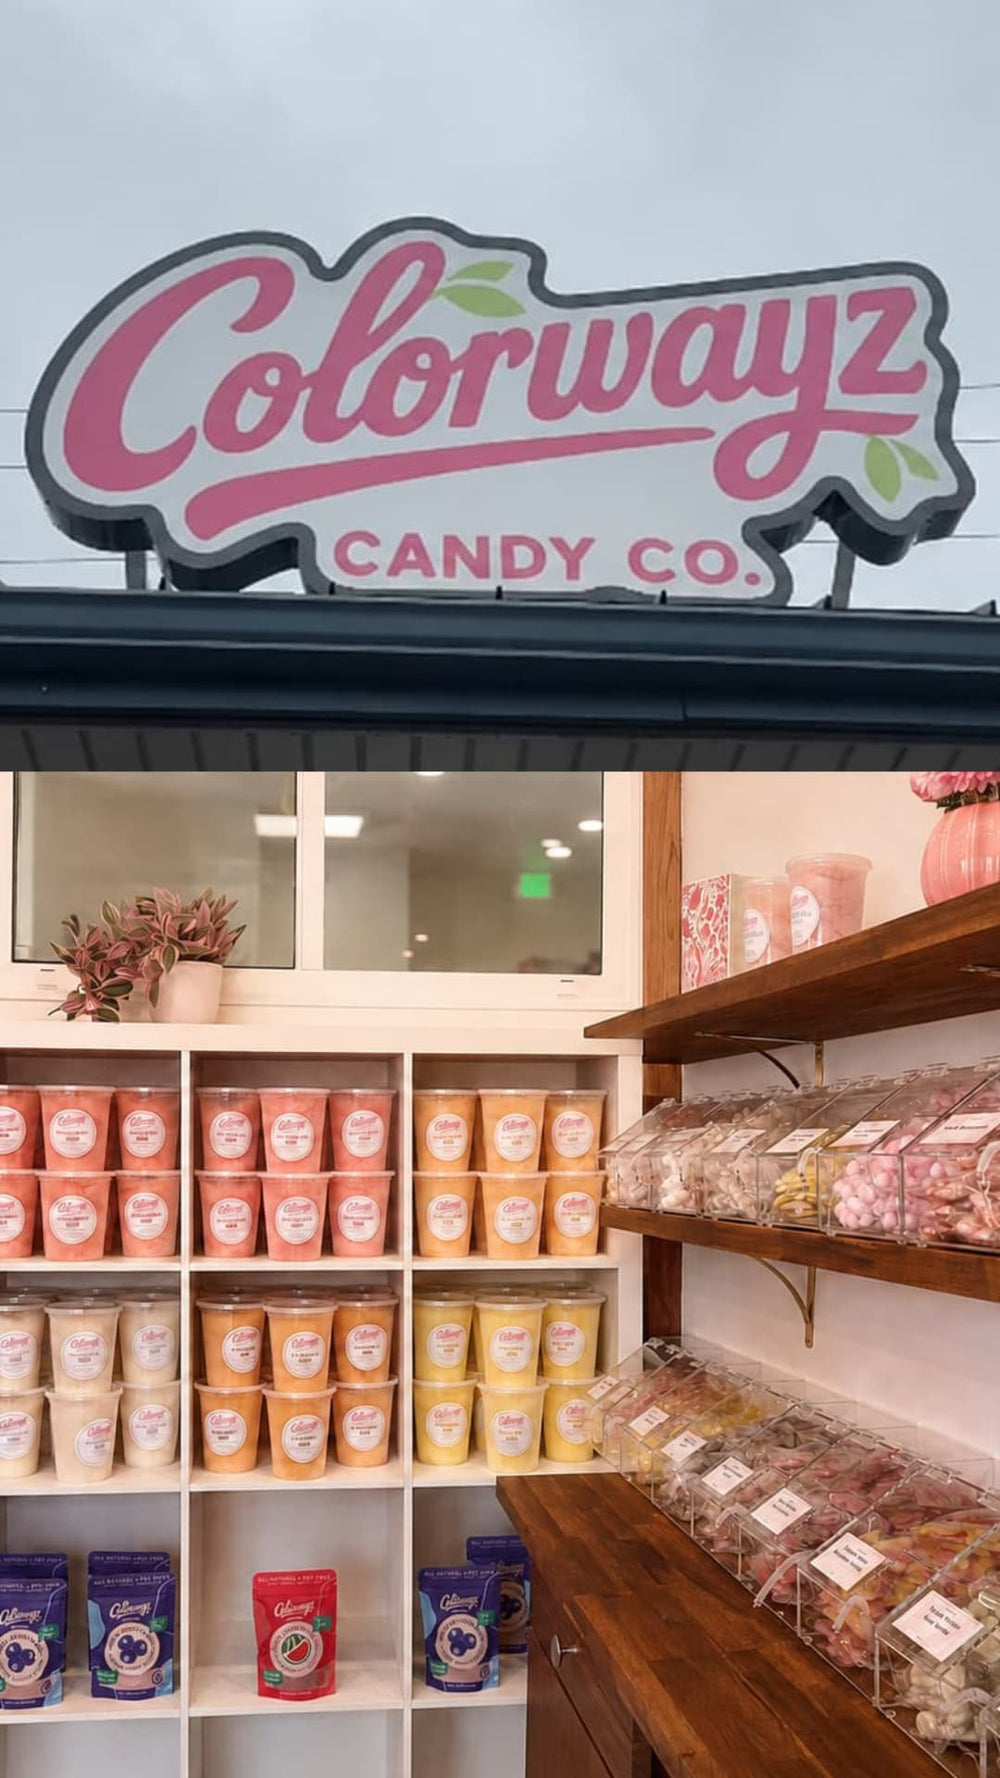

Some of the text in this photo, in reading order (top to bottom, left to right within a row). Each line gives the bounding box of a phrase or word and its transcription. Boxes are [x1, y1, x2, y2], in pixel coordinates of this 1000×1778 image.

[63, 240, 929, 502] Colorwayz
[333, 529, 761, 585] CANDY CO.
